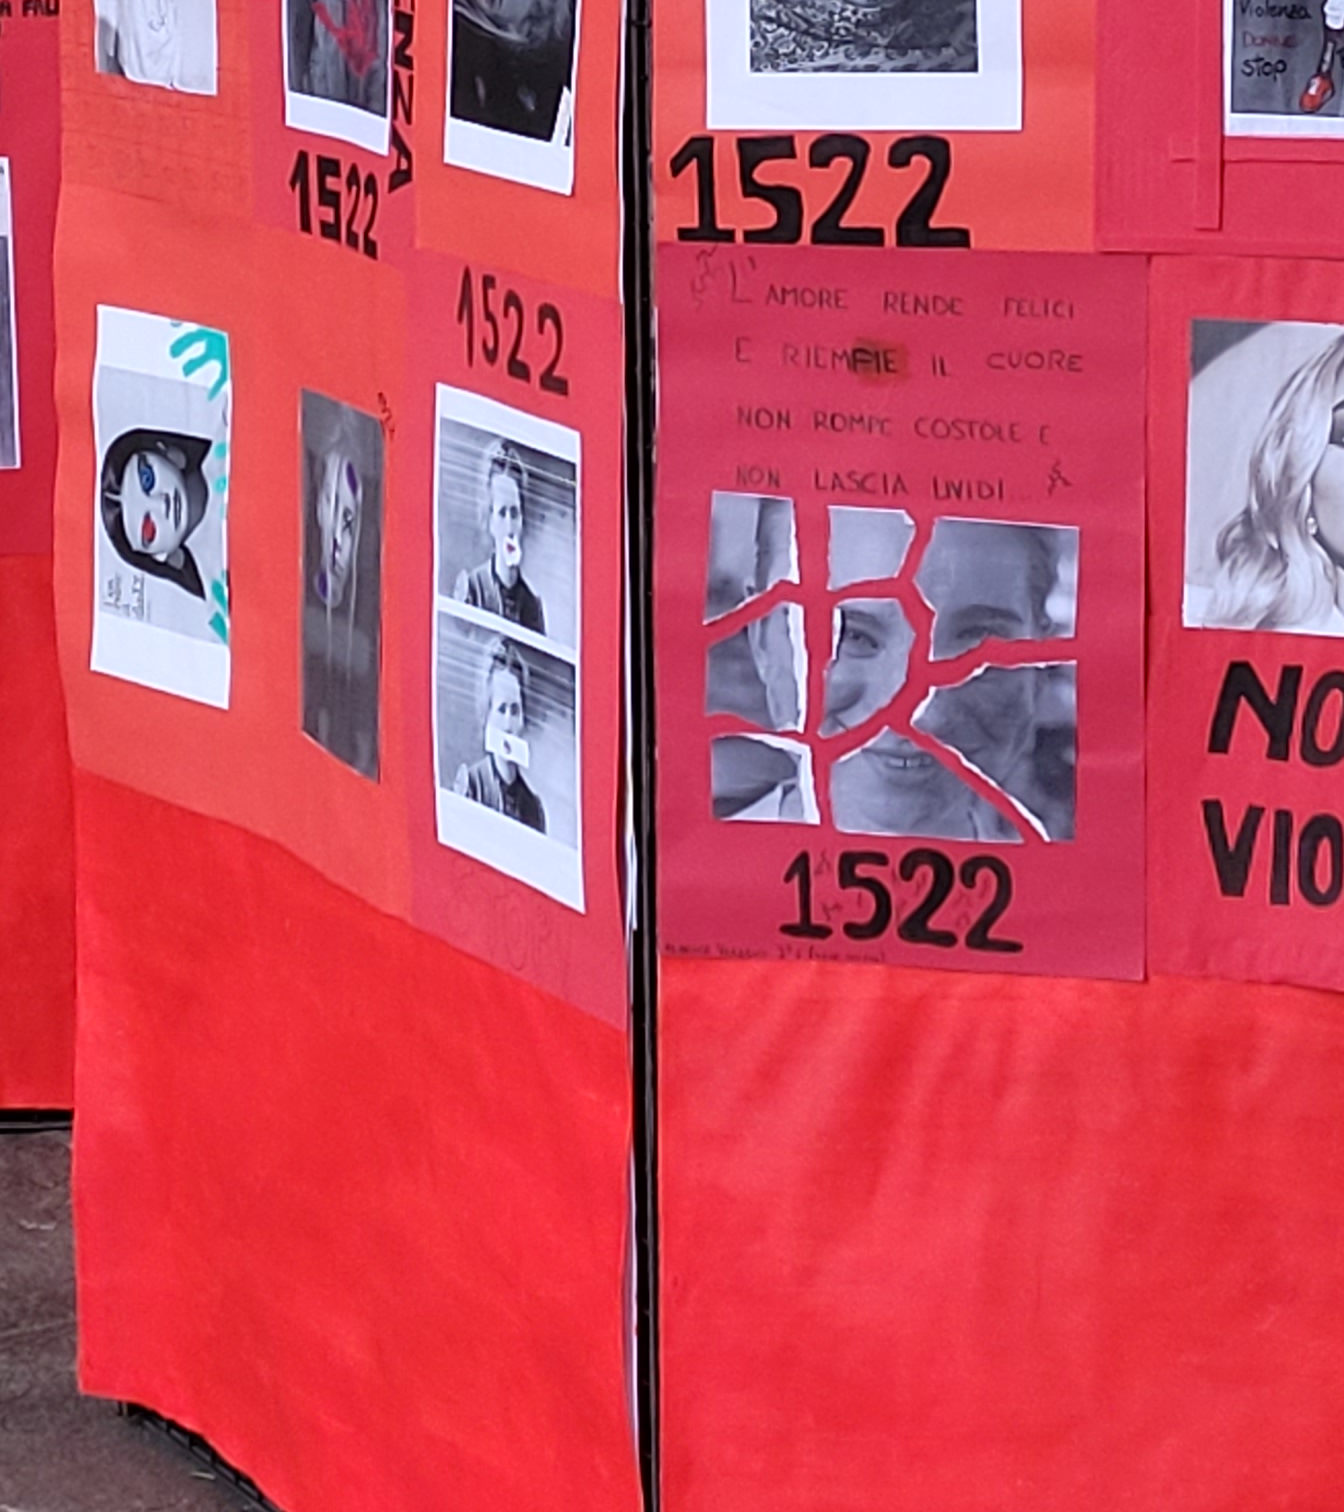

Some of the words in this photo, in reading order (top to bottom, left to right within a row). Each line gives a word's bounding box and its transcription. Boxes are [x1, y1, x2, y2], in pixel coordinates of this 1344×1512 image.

[288, 149, 379, 262] 1522
[668, 132, 972, 250] 1522
[456, 263, 570, 398] 1522
[883, 292, 965, 317] RENDE
[1003, 296, 1076, 320] FELICI
[735, 337, 752, 364] E
[931, 359, 951, 378] IL
[986, 350, 1084, 374] CUORE
[737, 406, 792, 432] NON
[914, 415, 1022, 444] COSTOLE
[734, 466, 781, 489] NON
[813, 468, 909, 497] LASCIA
[778, 846, 1025, 955] 1522
